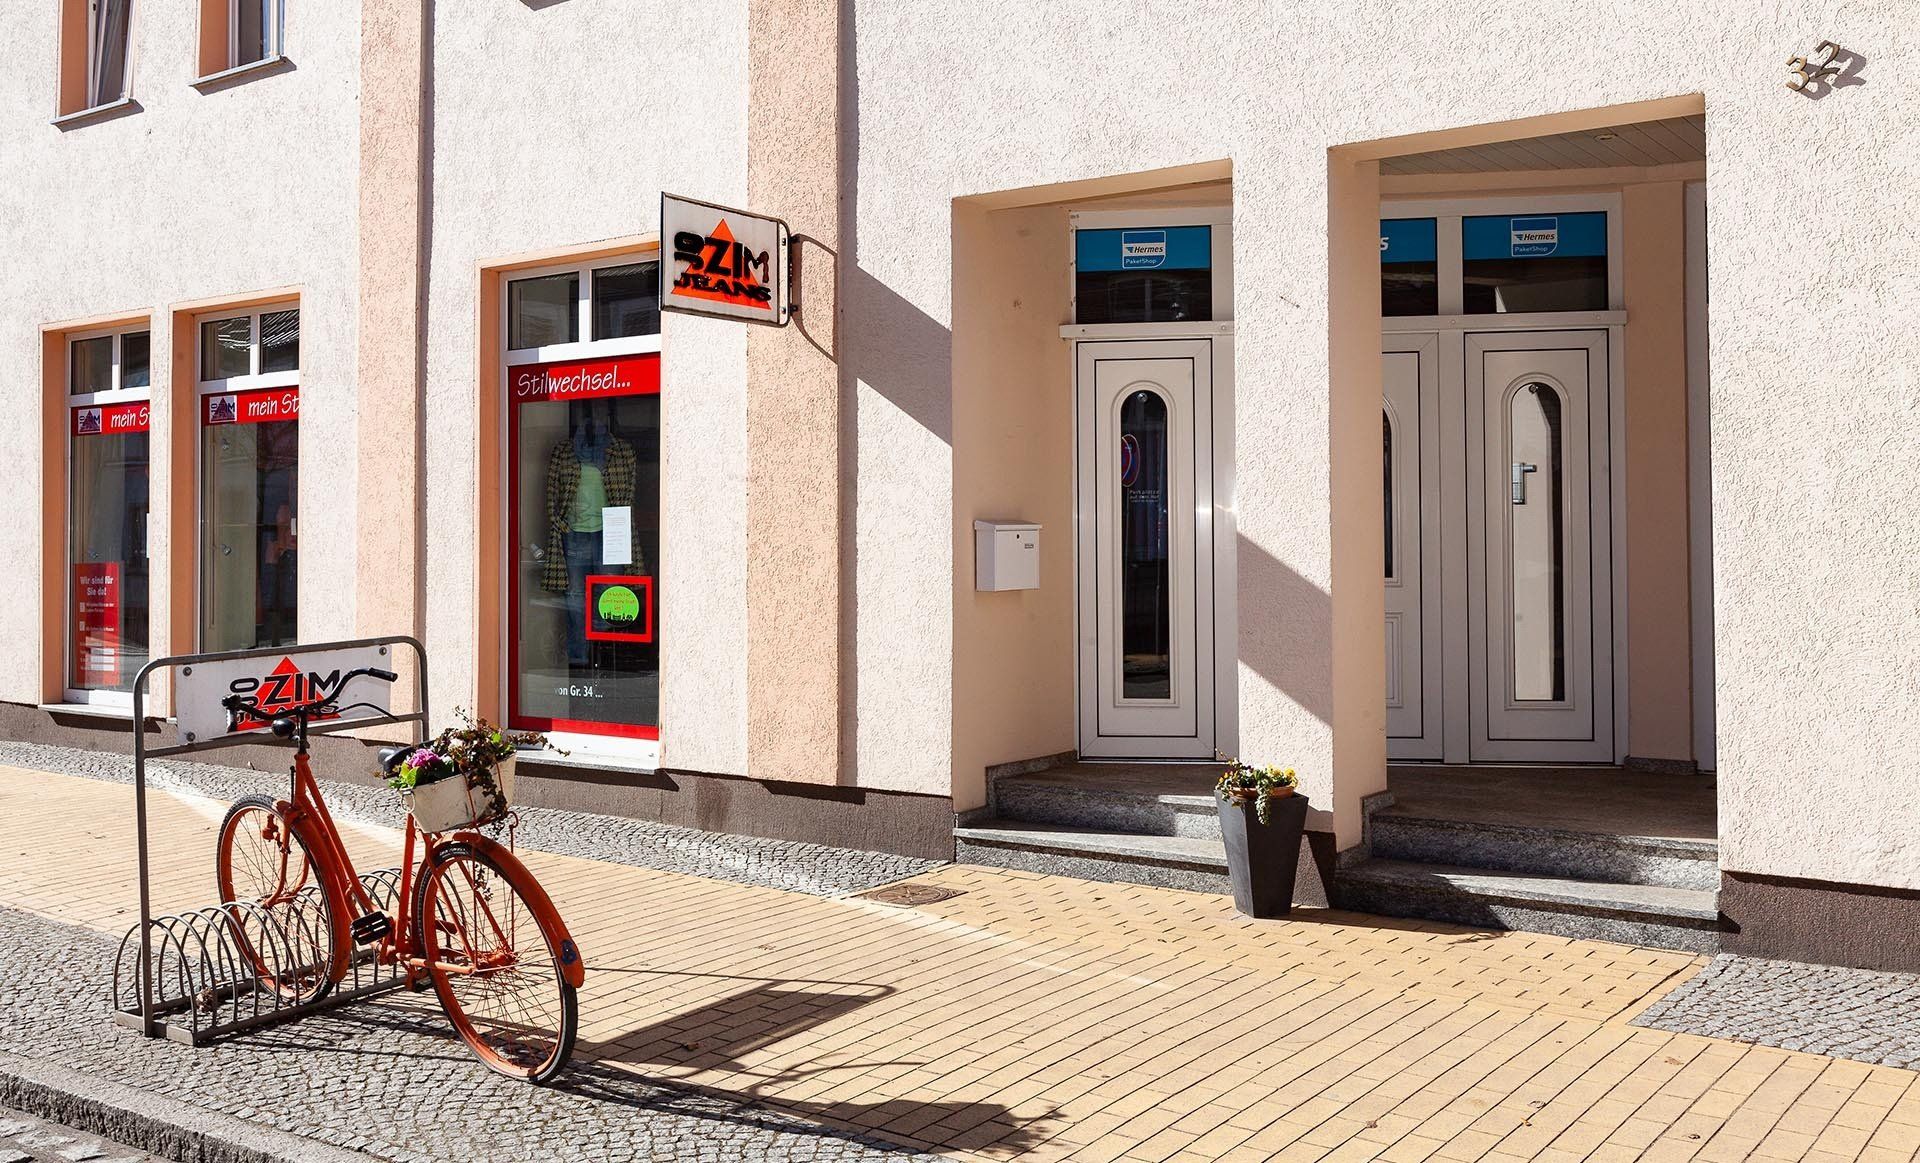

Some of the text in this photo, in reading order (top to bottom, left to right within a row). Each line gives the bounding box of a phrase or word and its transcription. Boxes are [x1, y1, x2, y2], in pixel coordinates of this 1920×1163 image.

[1786, 40, 1840, 91] 32
[1524, 233, 1555, 241] Hermes
[674, 231, 769, 283] OZIM
[673, 272, 772, 302] JEANS
[517, 364, 631, 397] Stilwechsel...
[248, 396, 278, 417] mein
[111, 409, 136, 428] mein
[80, 576, 114, 585] Wir sind für
[87, 586, 107, 596] Sie da!
[230, 669, 340, 709] OZIM
[554, 687, 568, 696] von
[570, 685, 581, 696] Gr.
[583, 685, 593, 698] 34
